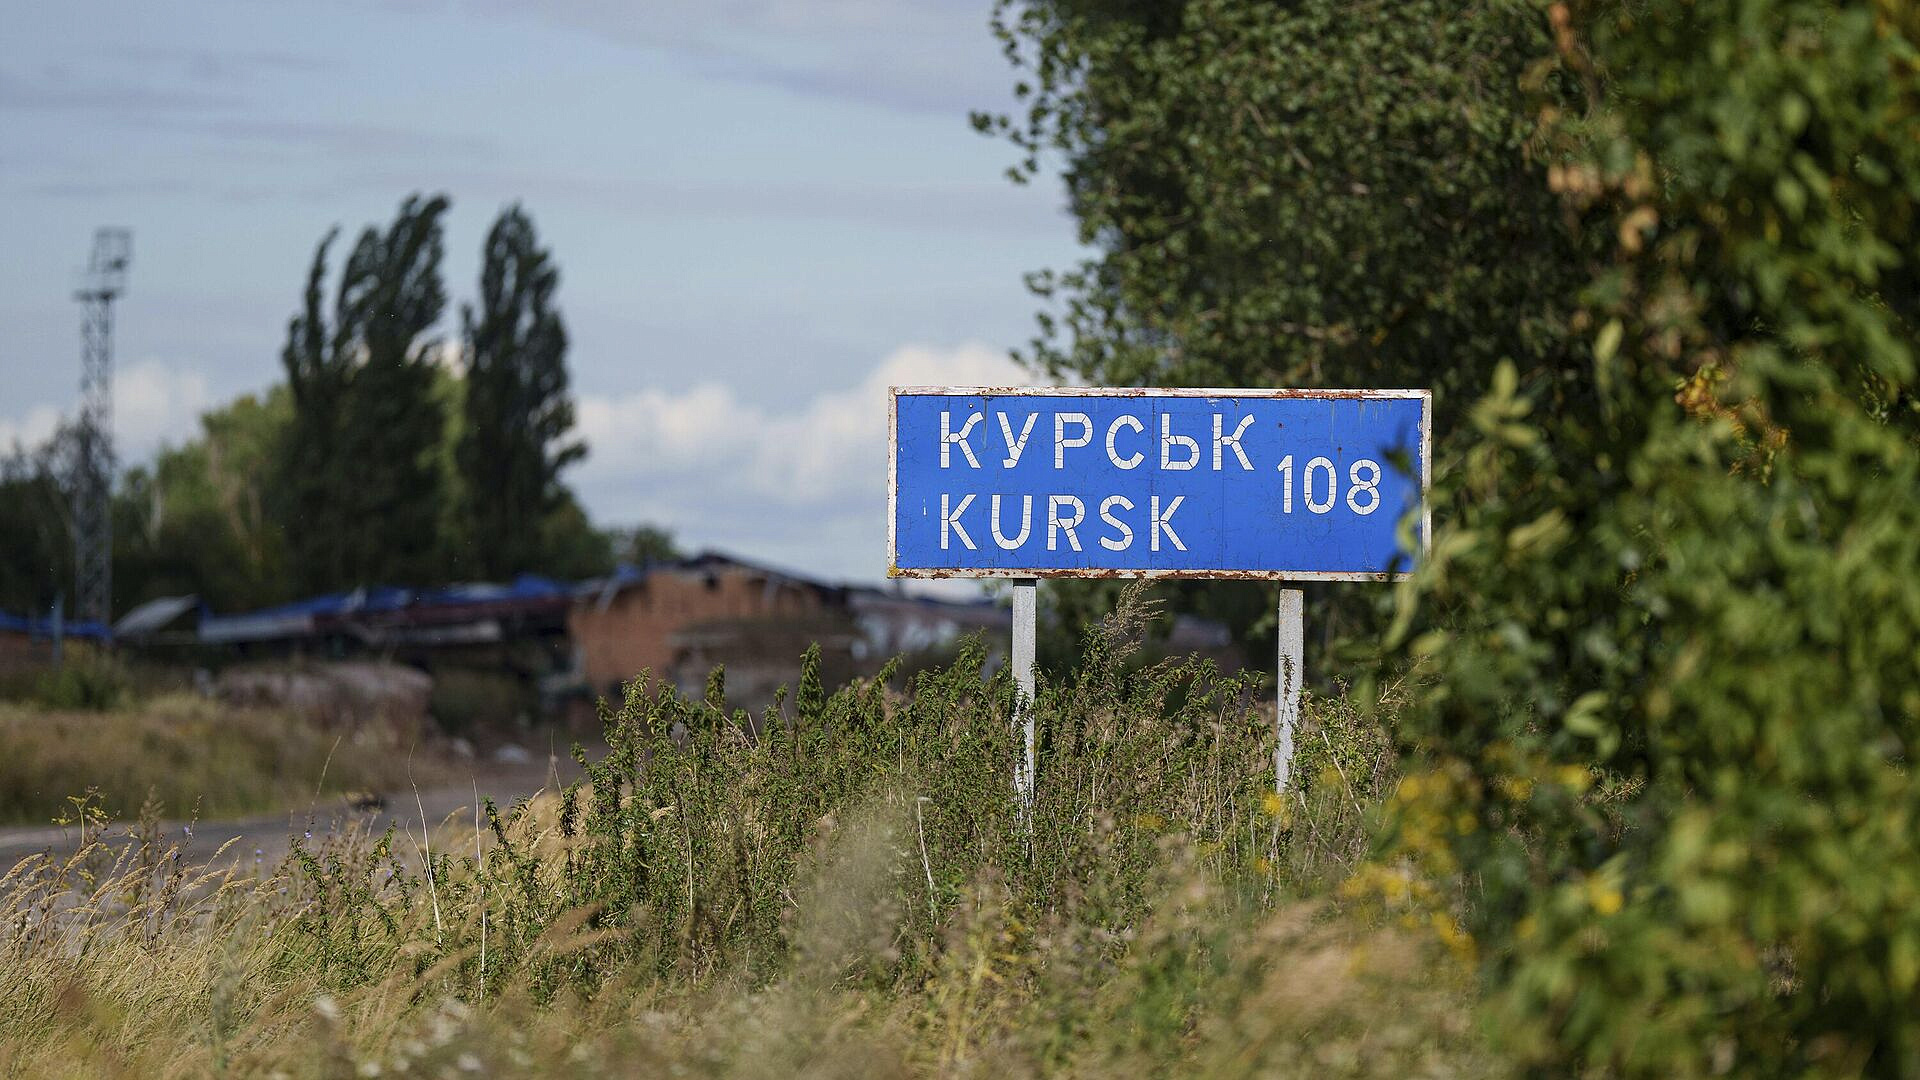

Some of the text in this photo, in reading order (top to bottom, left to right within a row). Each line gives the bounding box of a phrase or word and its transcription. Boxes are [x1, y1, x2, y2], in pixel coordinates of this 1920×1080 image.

[940, 411, 1256, 471] КУРСЬК
[1276, 454, 1382, 516] 108
[940, 493, 1189, 552] KURSK
